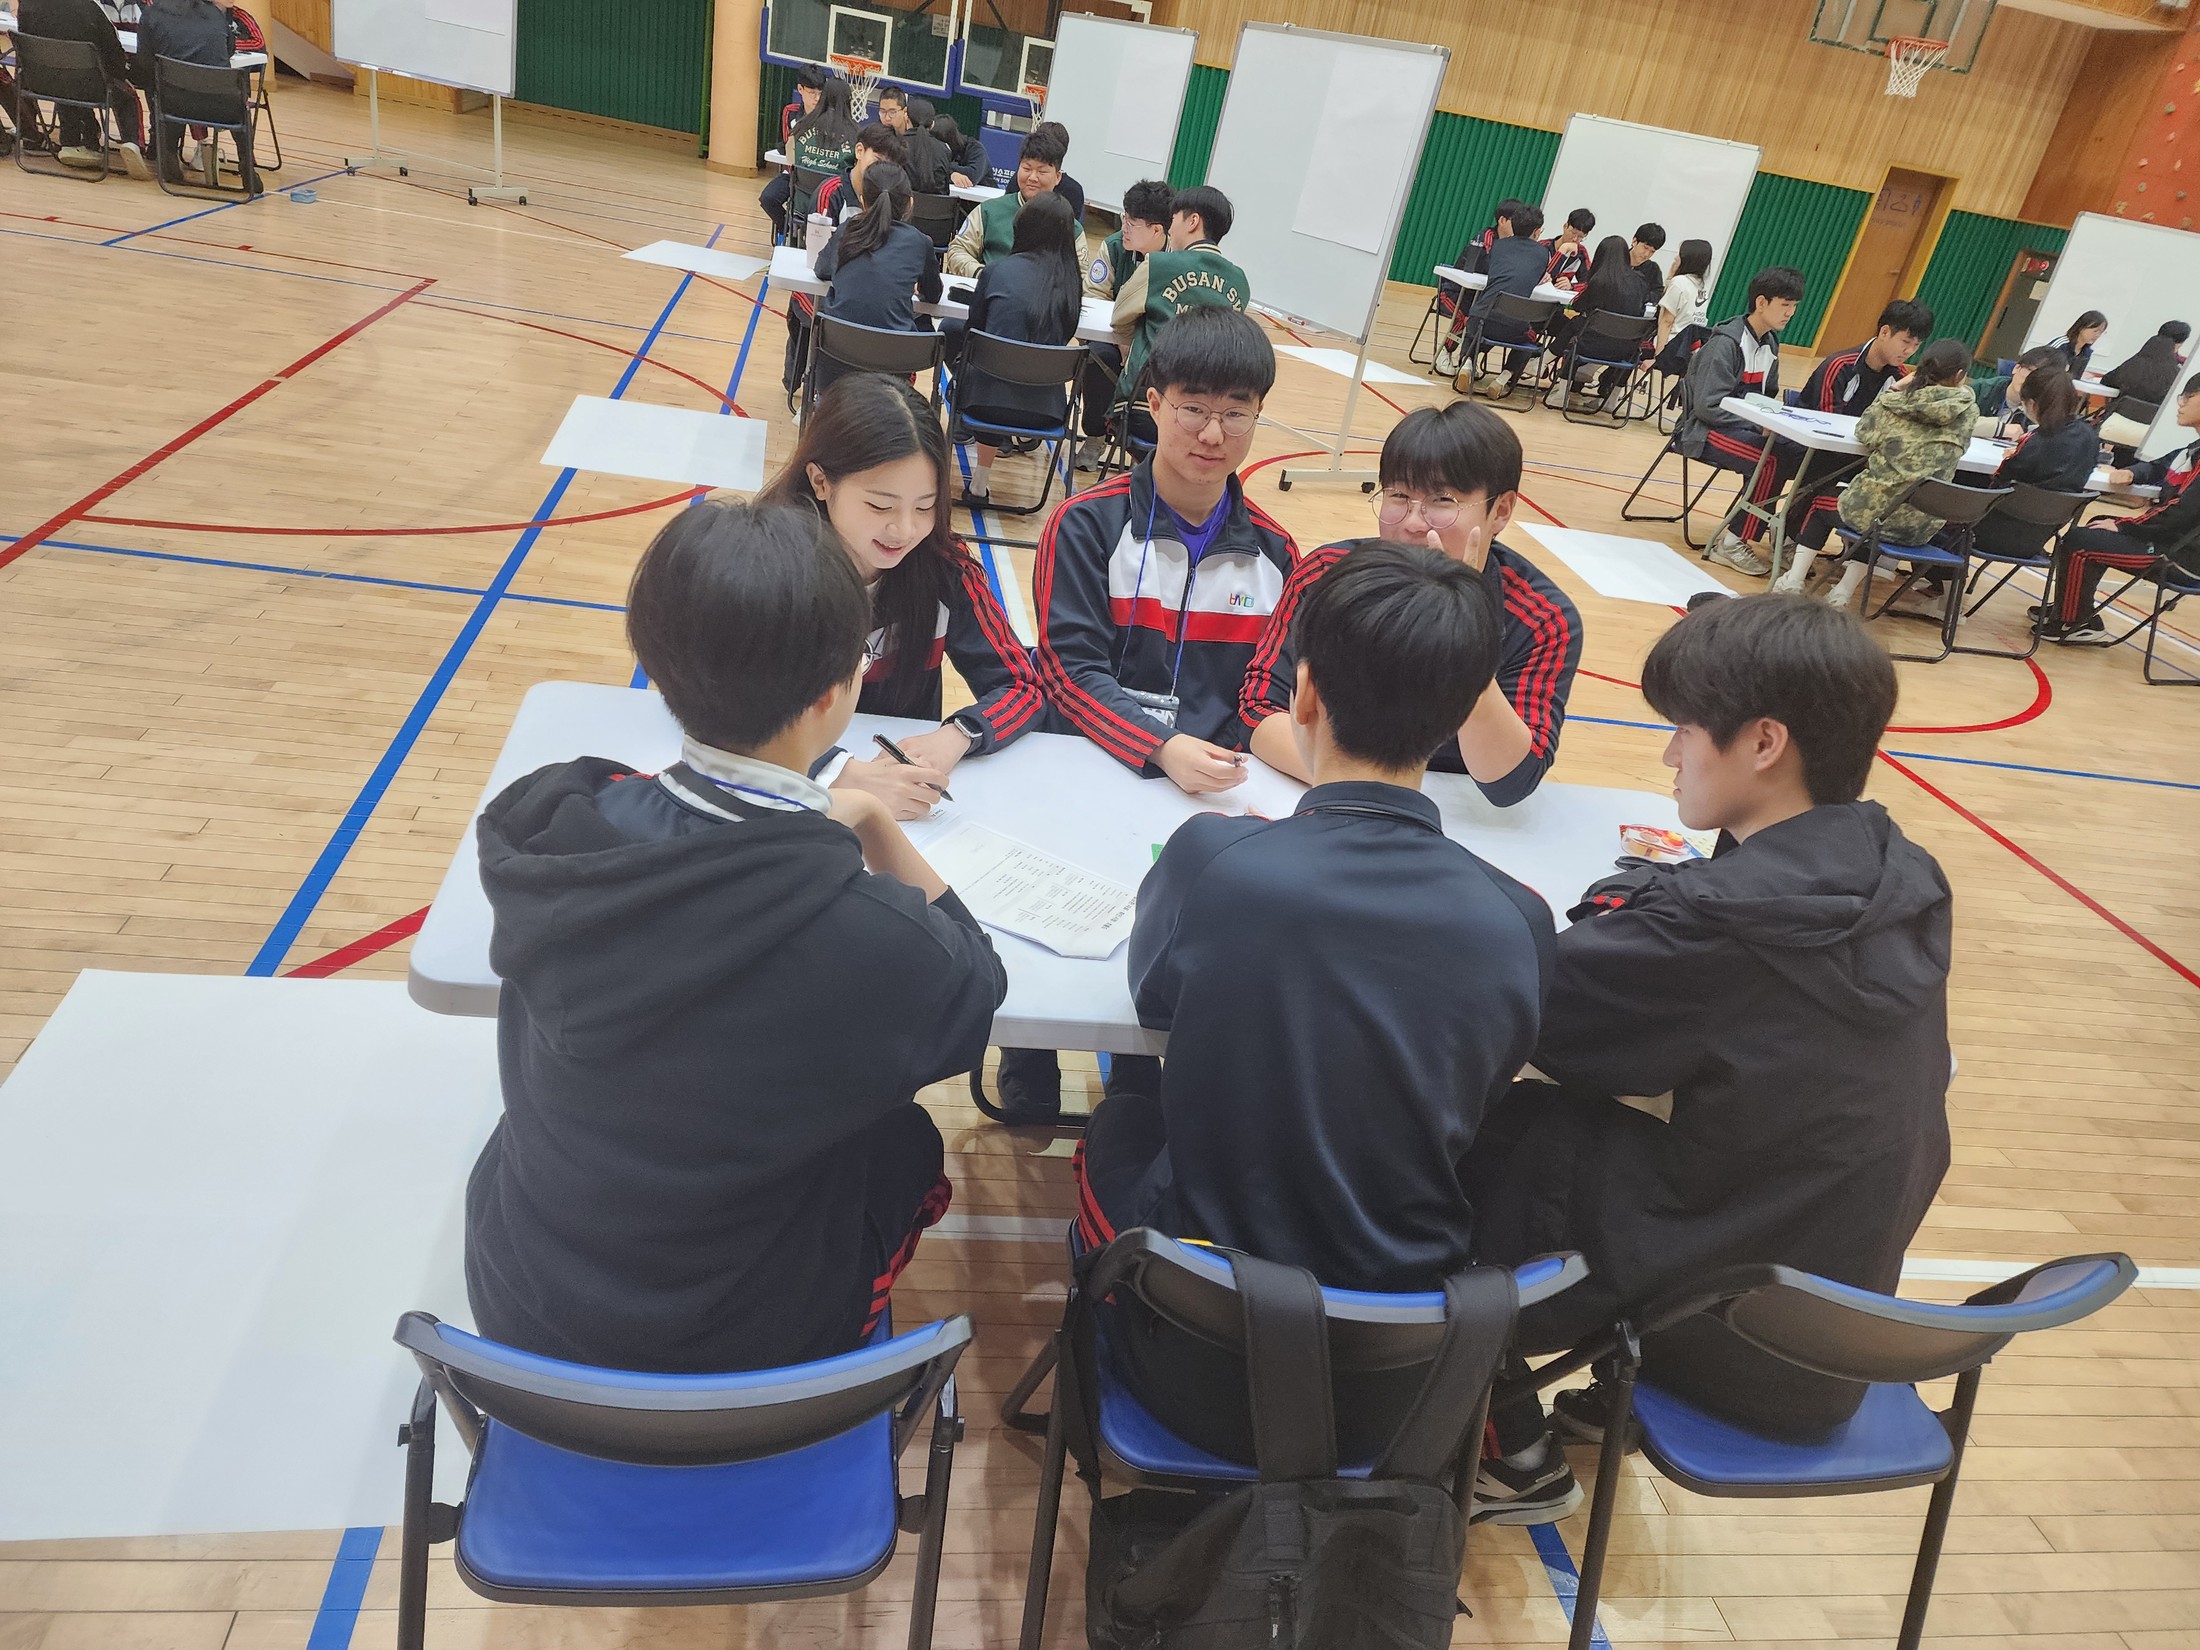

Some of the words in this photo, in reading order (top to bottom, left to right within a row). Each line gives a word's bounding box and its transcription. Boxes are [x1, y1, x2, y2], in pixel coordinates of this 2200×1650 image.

[804, 144, 840, 159] MEISTER
[801, 155, 817, 167] High
[817, 159, 839, 170] School
[1161, 271, 1225, 303] BUSAN
